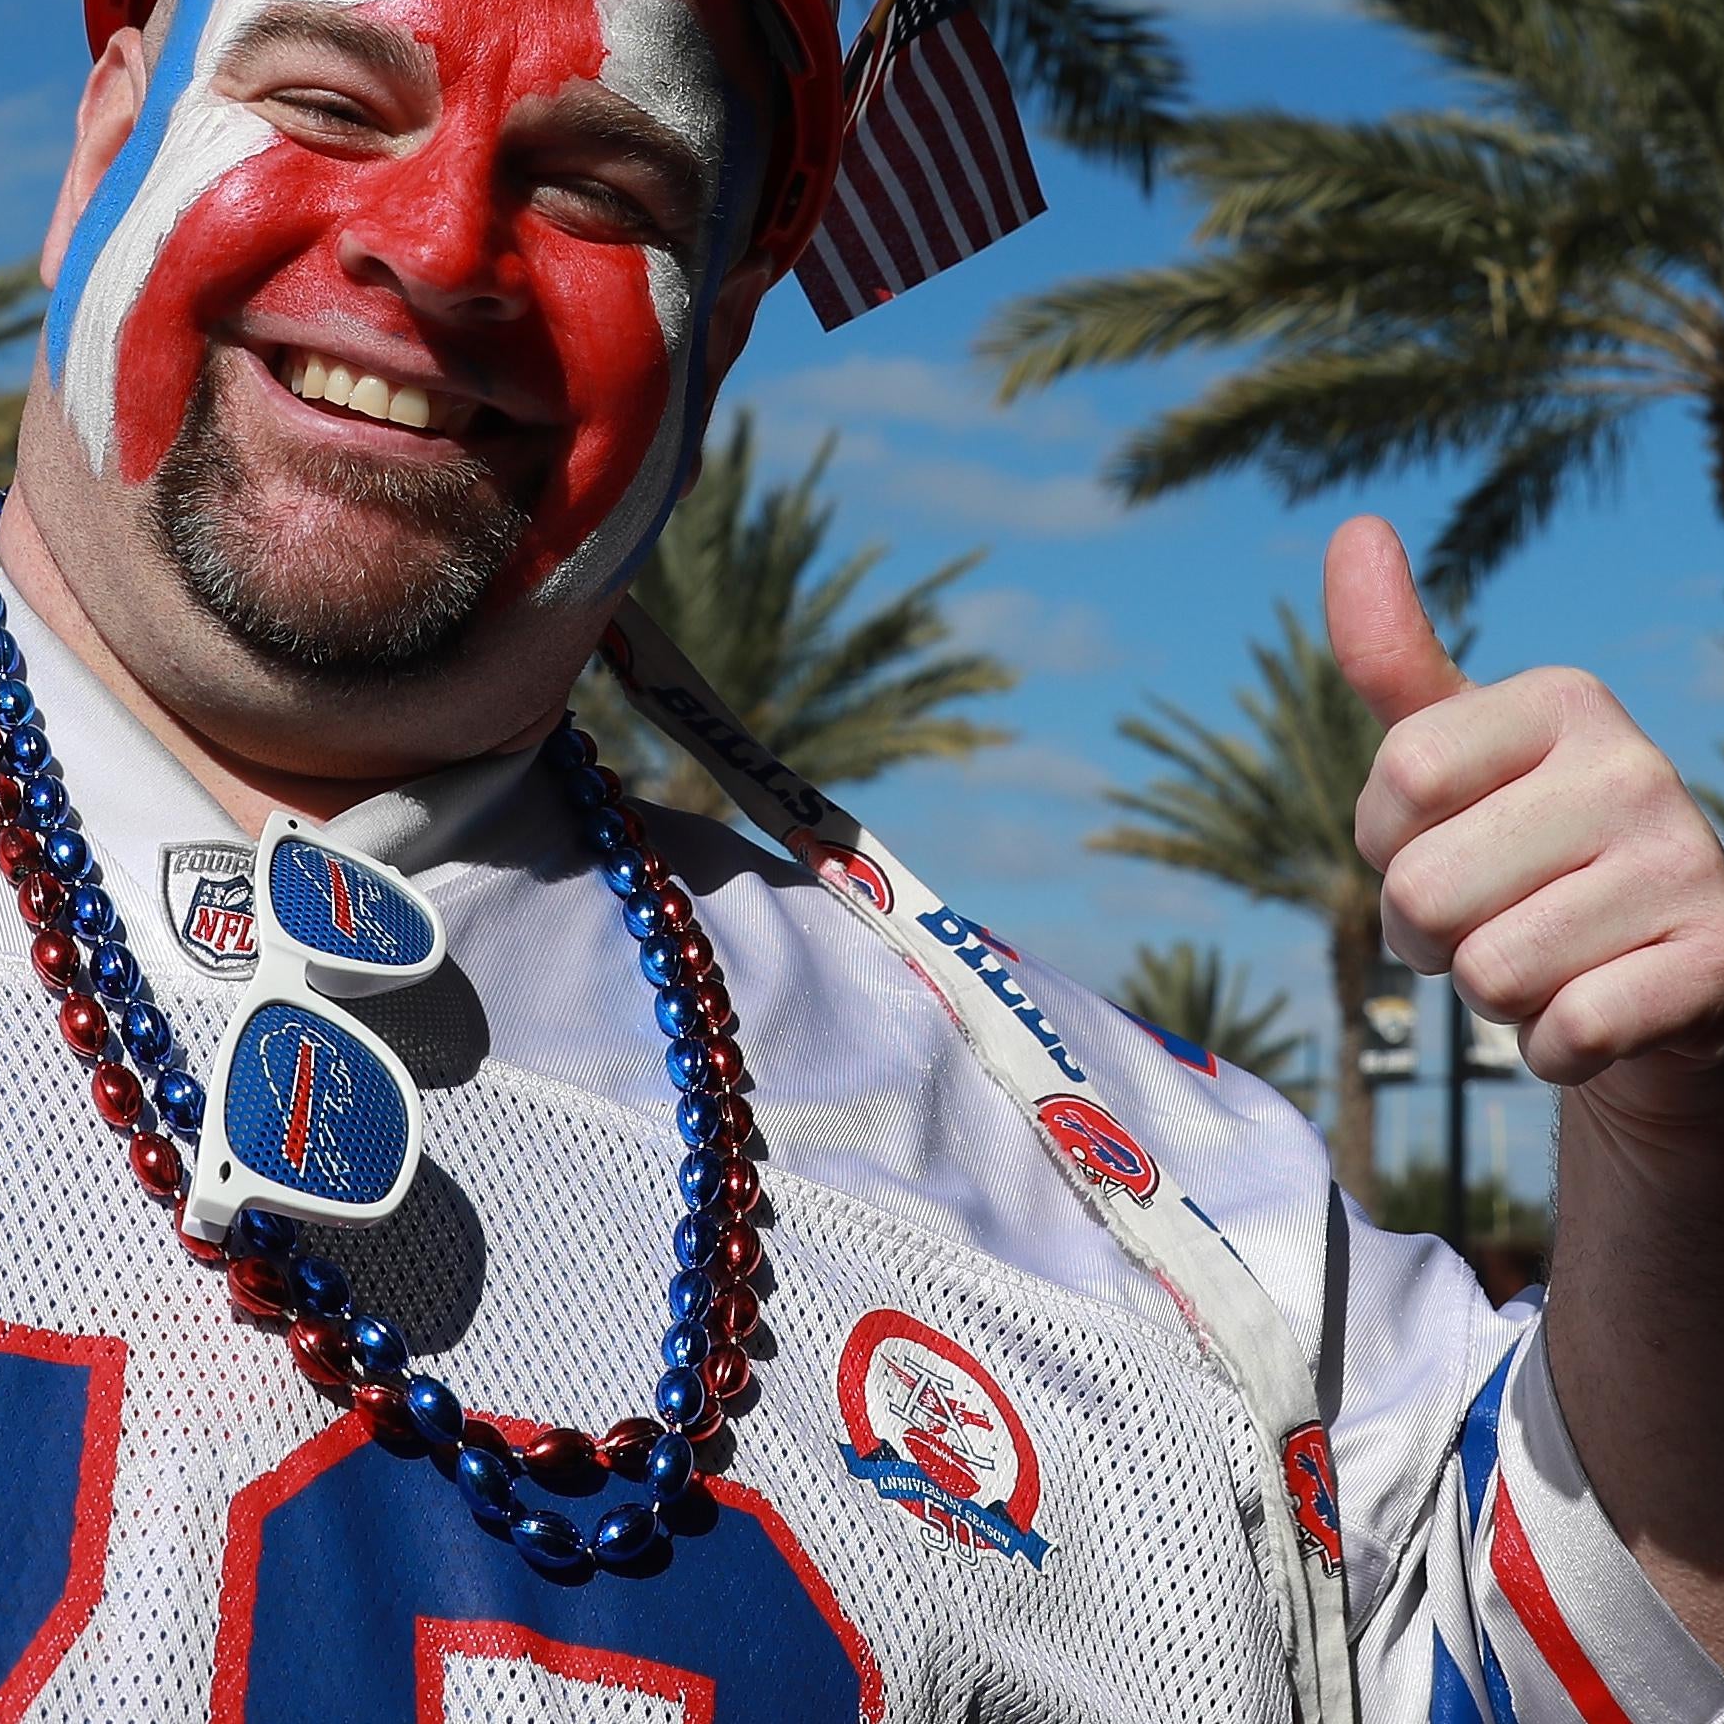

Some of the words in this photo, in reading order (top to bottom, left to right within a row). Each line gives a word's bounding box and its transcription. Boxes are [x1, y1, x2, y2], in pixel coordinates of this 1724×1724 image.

[648, 686, 837, 826] BILLS
[193, 907, 254, 952] NFL
[879, 1476, 963, 1514] ANNIVERSARY
[964, 1509, 1011, 1549] SEASON
